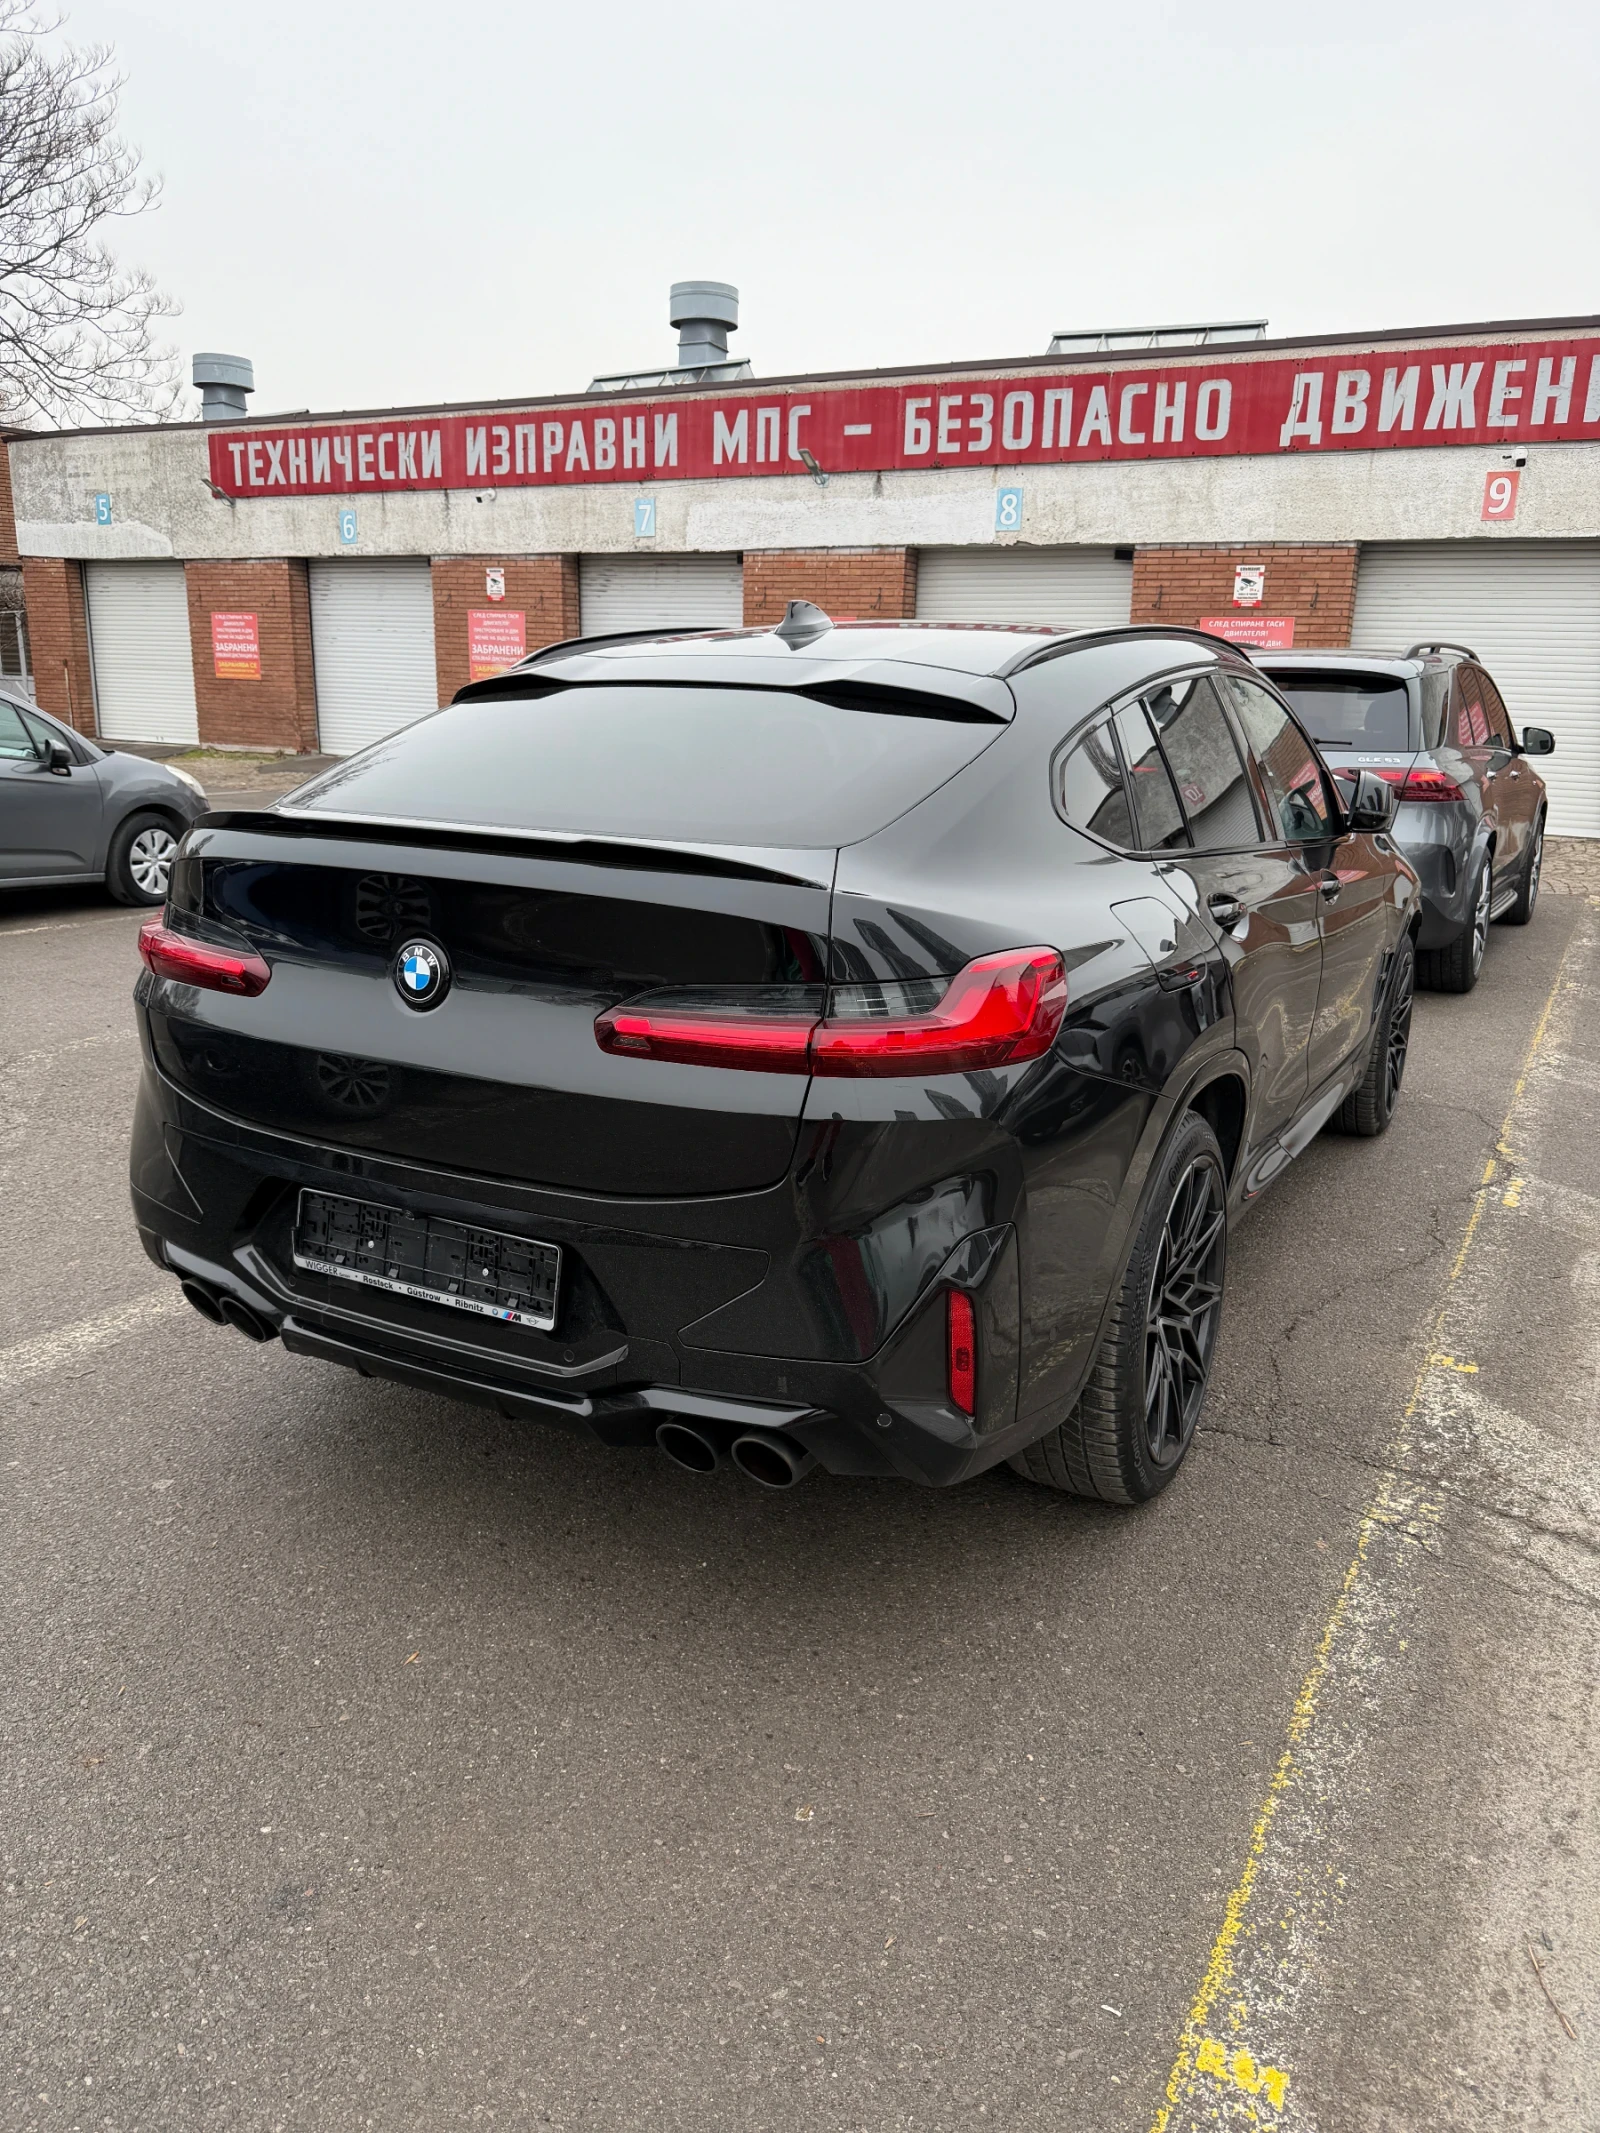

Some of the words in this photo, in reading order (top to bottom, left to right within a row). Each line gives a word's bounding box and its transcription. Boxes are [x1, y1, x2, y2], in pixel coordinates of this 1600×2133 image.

[228, 428, 442, 487] ТЕХНИЧЕСКИ
[466, 413, 679, 477] ИЗПРАВНИ
[713, 405, 812, 465] МПС
[903, 378, 1233, 456] БЕЗОПАСНО
[1487, 476, 1512, 514] 9
[99, 498, 108, 521] 5
[638, 504, 651, 532] 7
[999, 493, 1018, 526] 8
[343, 514, 354, 540] 6
[1208, 620, 1229, 628] СЛЕД
[1266, 620, 1285, 628] ГАСИ
[215, 642, 258, 653] ЗАБРАНЕНИ
[471, 644, 524, 656] ЗАБРАНЕНИ
[1357, 756, 1382, 764] GLE
[401, 947, 437, 967] BMW
[305, 1260, 338, 1275] WIGGER
[406, 1286, 441, 1302] Güstrow
[454, 1299, 485, 1313] Ribnitz
